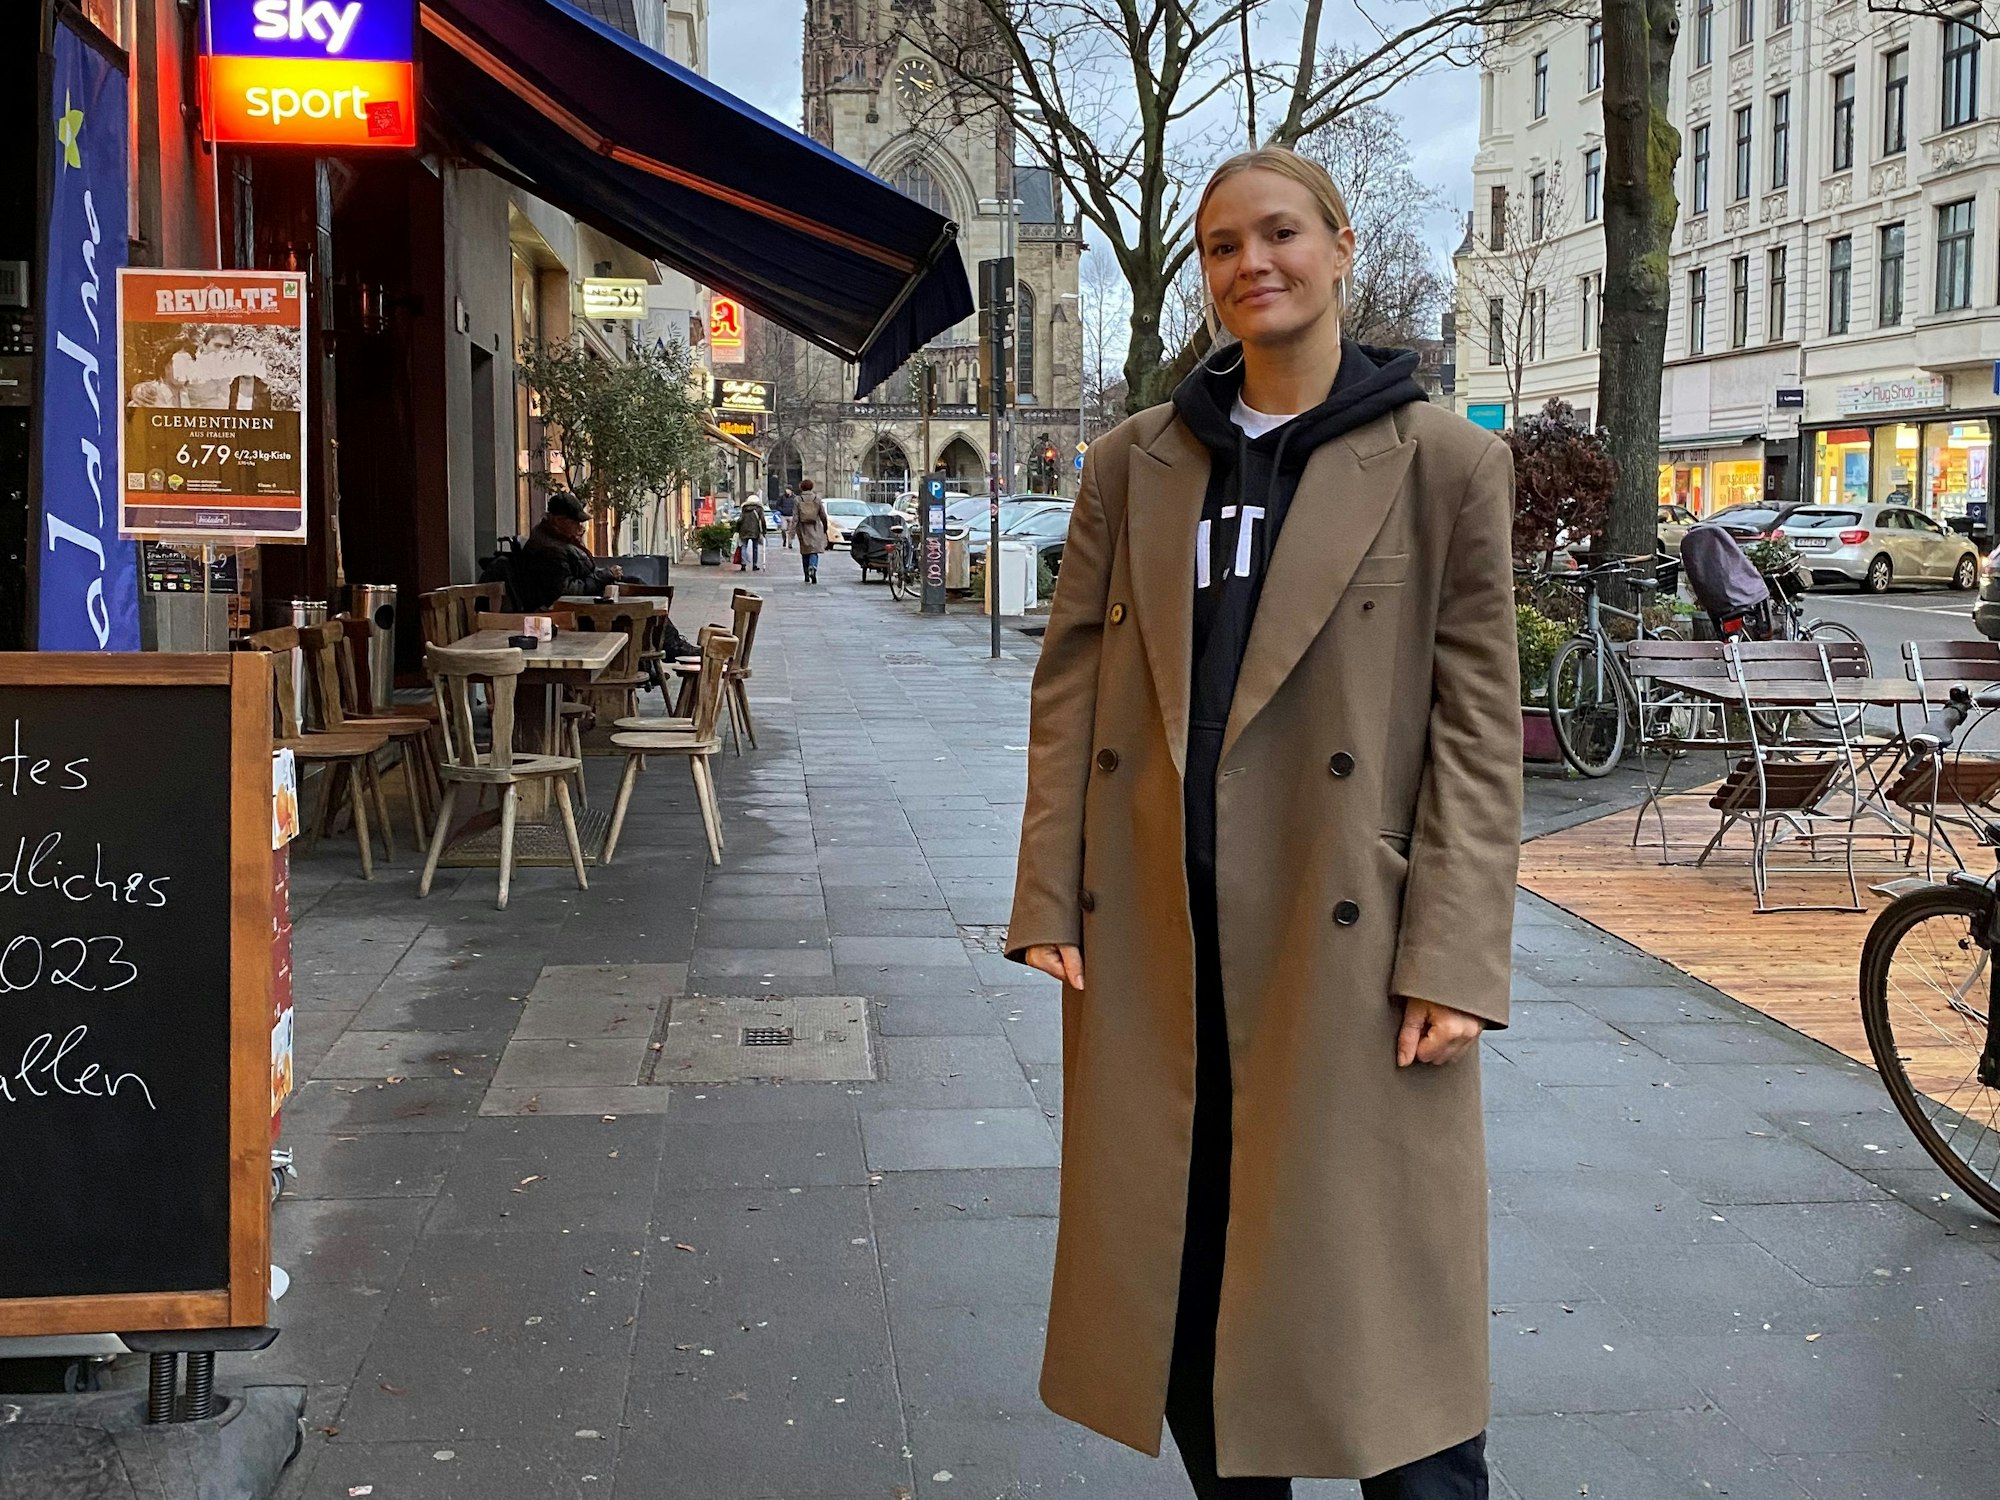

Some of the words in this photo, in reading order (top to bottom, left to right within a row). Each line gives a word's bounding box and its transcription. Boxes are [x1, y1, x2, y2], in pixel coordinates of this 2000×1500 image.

[253, 0, 362, 53] sky
[245, 85, 370, 125] sport
[156, 288, 278, 312] REVOLTE
[609, 286, 639, 308] 59
[151, 415, 274, 430] CLEMENTINEN
[176, 443, 231, 468] 6,79
[0, 719, 89, 795] tes
[0, 935, 138, 993] 023
